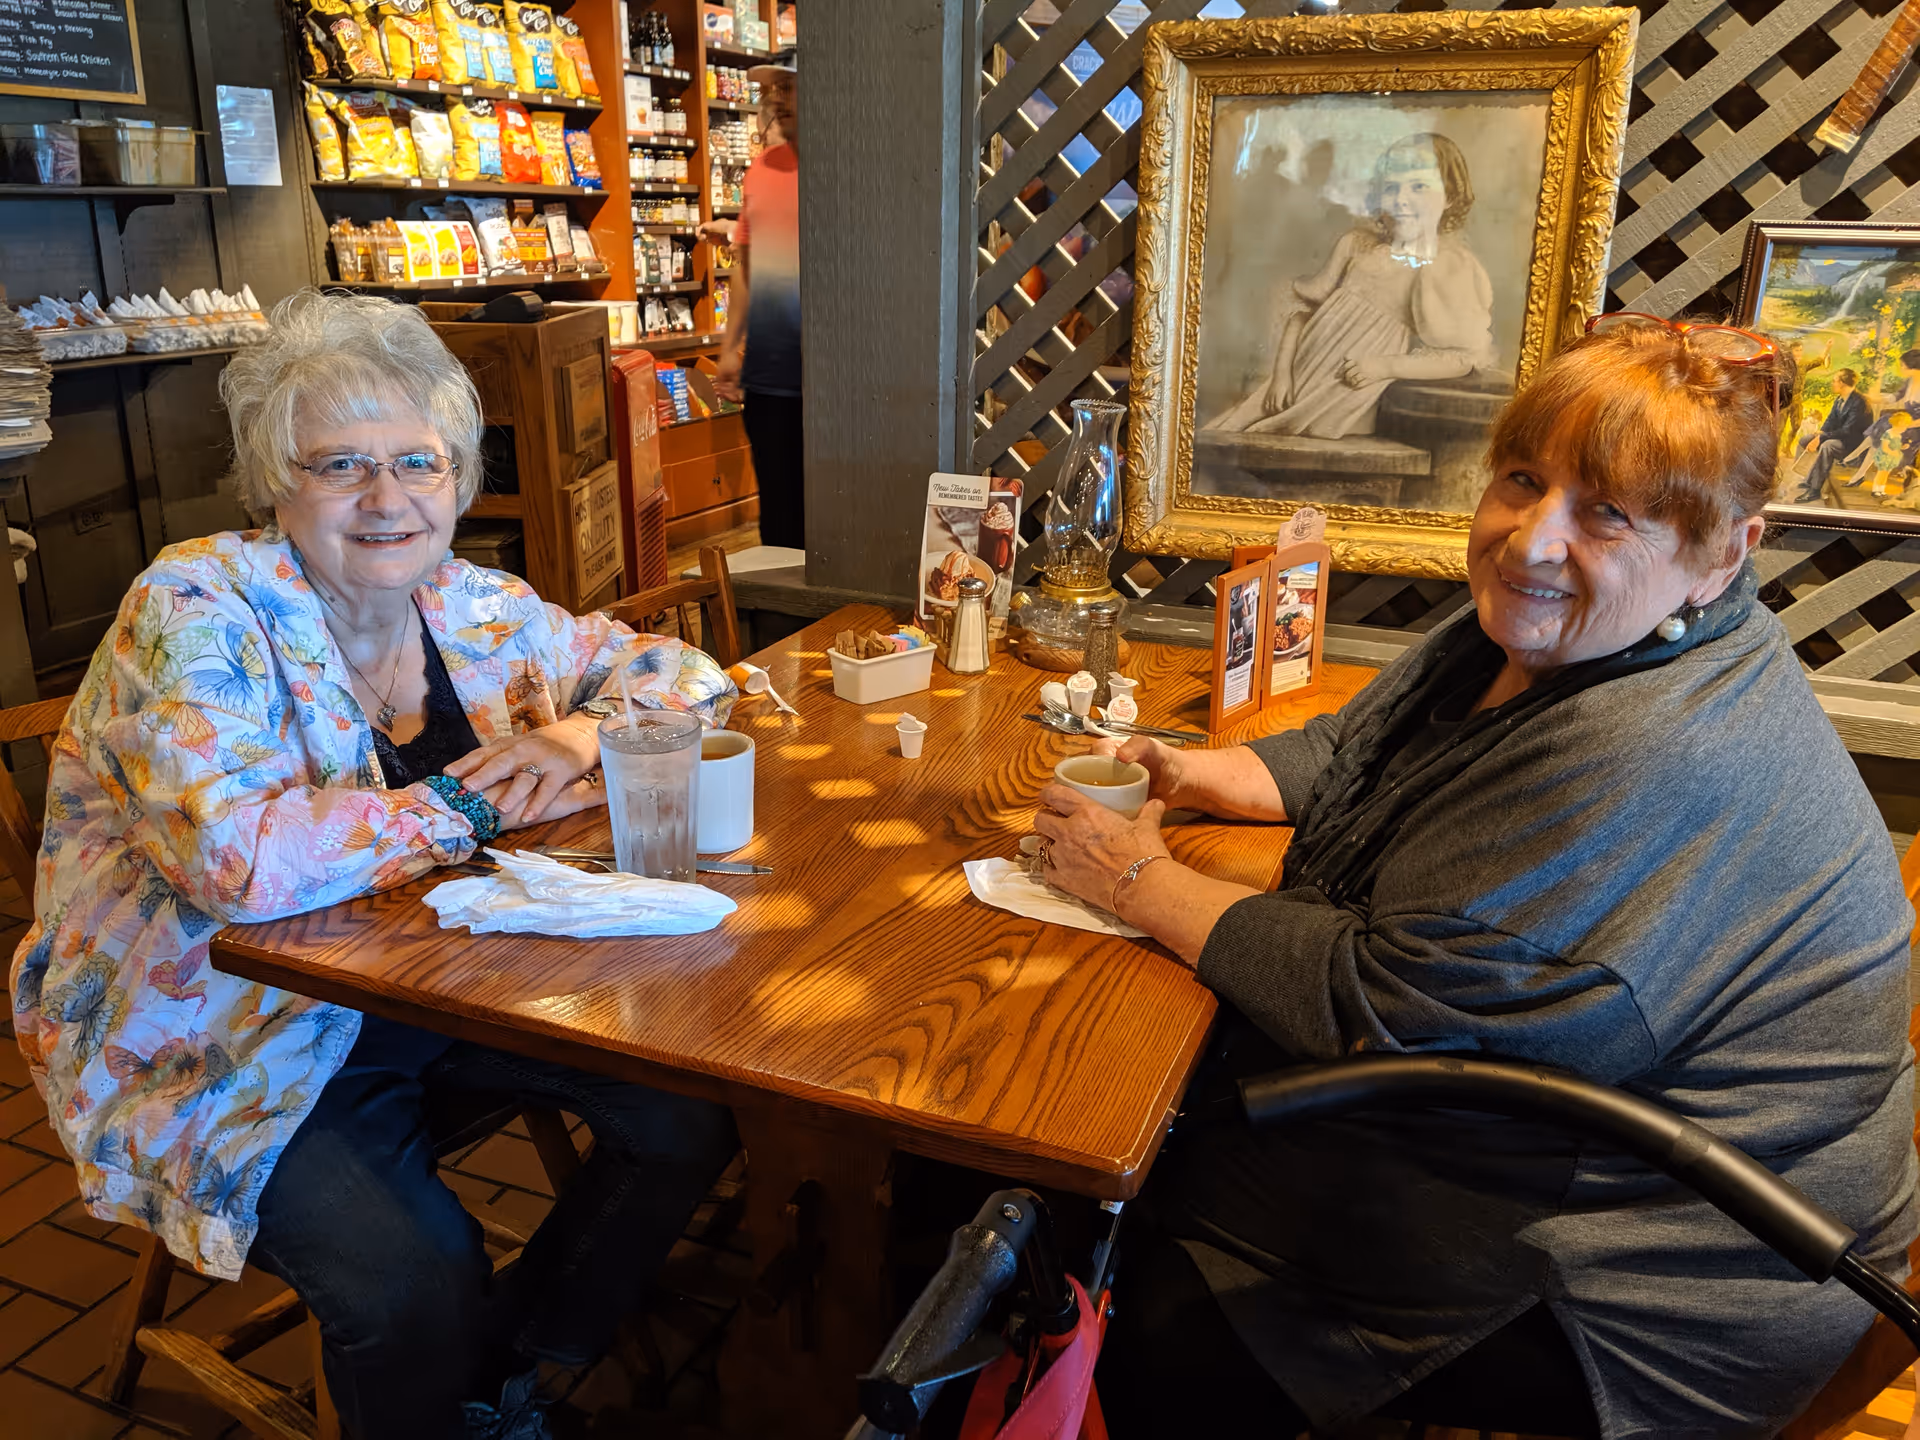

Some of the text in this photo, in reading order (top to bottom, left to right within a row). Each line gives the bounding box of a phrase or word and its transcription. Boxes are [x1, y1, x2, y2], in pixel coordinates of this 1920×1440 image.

[30, 21, 56, 34] Turkey
[39, 35, 53, 50] Fry
[60, 51, 79, 64] Fried
[81, 54, 111, 65] Chicken
[933, 484, 949, 492] New
[950, 484, 971, 493] Takes
